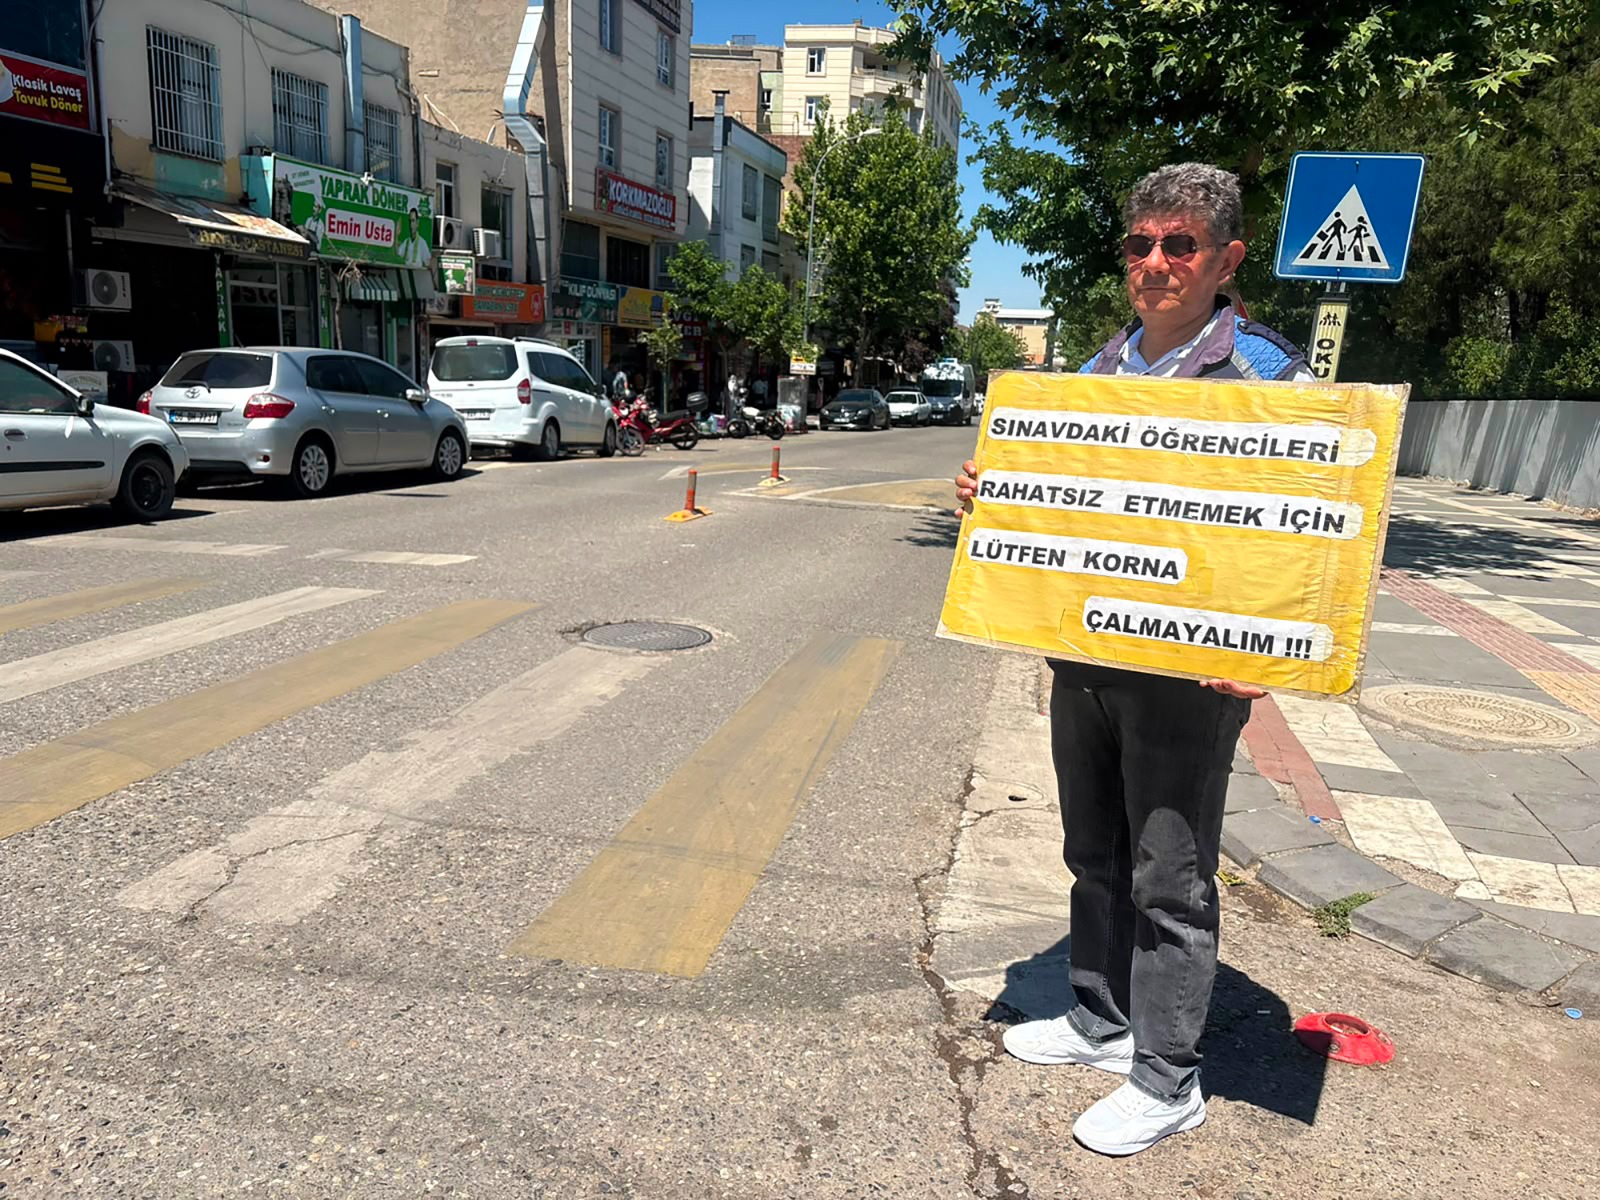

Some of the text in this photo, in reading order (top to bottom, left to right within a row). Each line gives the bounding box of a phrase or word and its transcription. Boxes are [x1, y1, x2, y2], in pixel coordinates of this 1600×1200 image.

[12, 73, 82, 102] Klasik Lavaş
[14, 90, 83, 113] Tavuk Döner
[319, 174, 370, 205] YAPRAK
[372, 185, 409, 213] DÖNER
[327, 213, 392, 243] Emin Usta
[991, 416, 1340, 464] SINAVDAKİ ÖĞRENCİLERİ
[978, 478, 1346, 535] RAHATSIZ ETMEMEK İÇİN
[970, 538, 1180, 580] LÜTFEN KORNA
[1085, 608, 1314, 661] ÇALMAYALIM !!!
